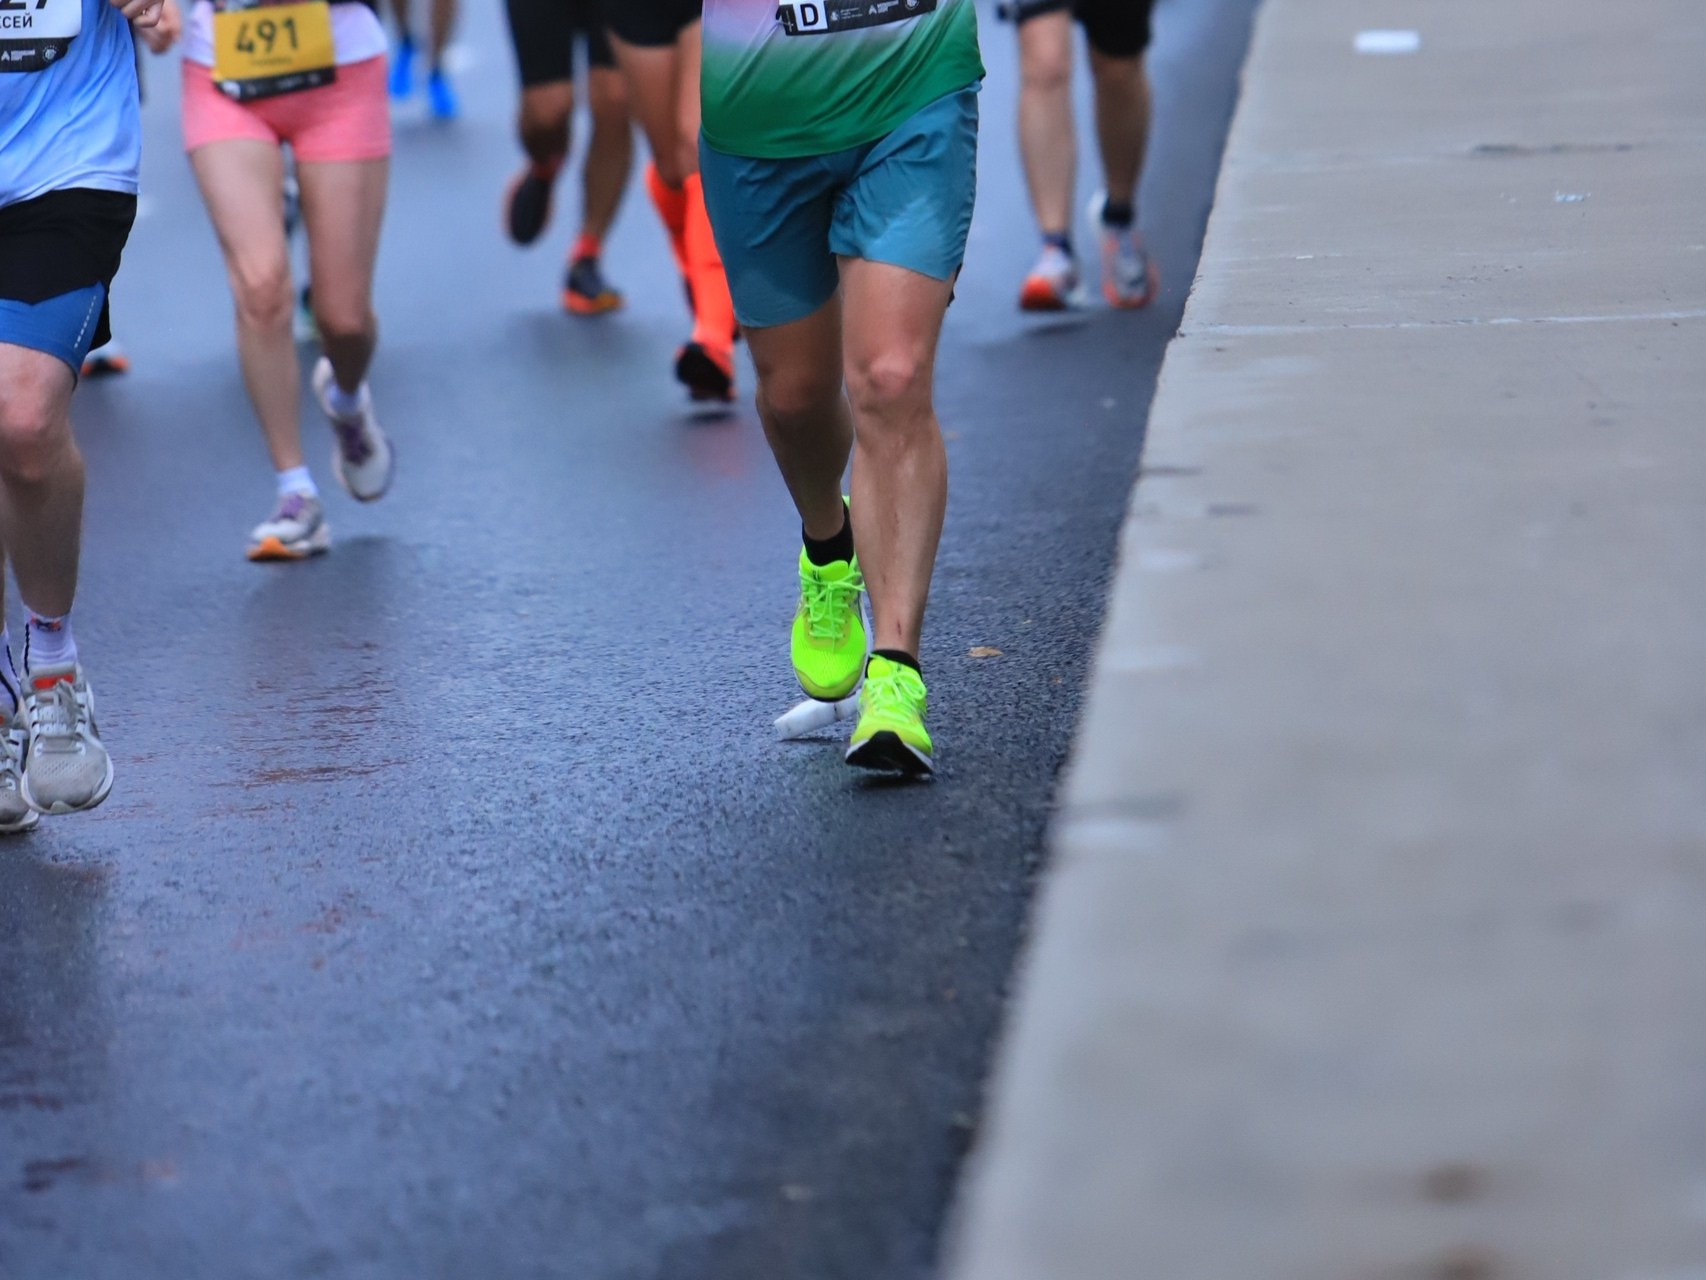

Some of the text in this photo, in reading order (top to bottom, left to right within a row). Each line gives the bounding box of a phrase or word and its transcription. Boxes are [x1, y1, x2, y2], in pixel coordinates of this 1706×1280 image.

[0, 12, 33, 29] СЕЙ
[800, 3, 819, 27] D
[236, 15, 299, 54] 491
